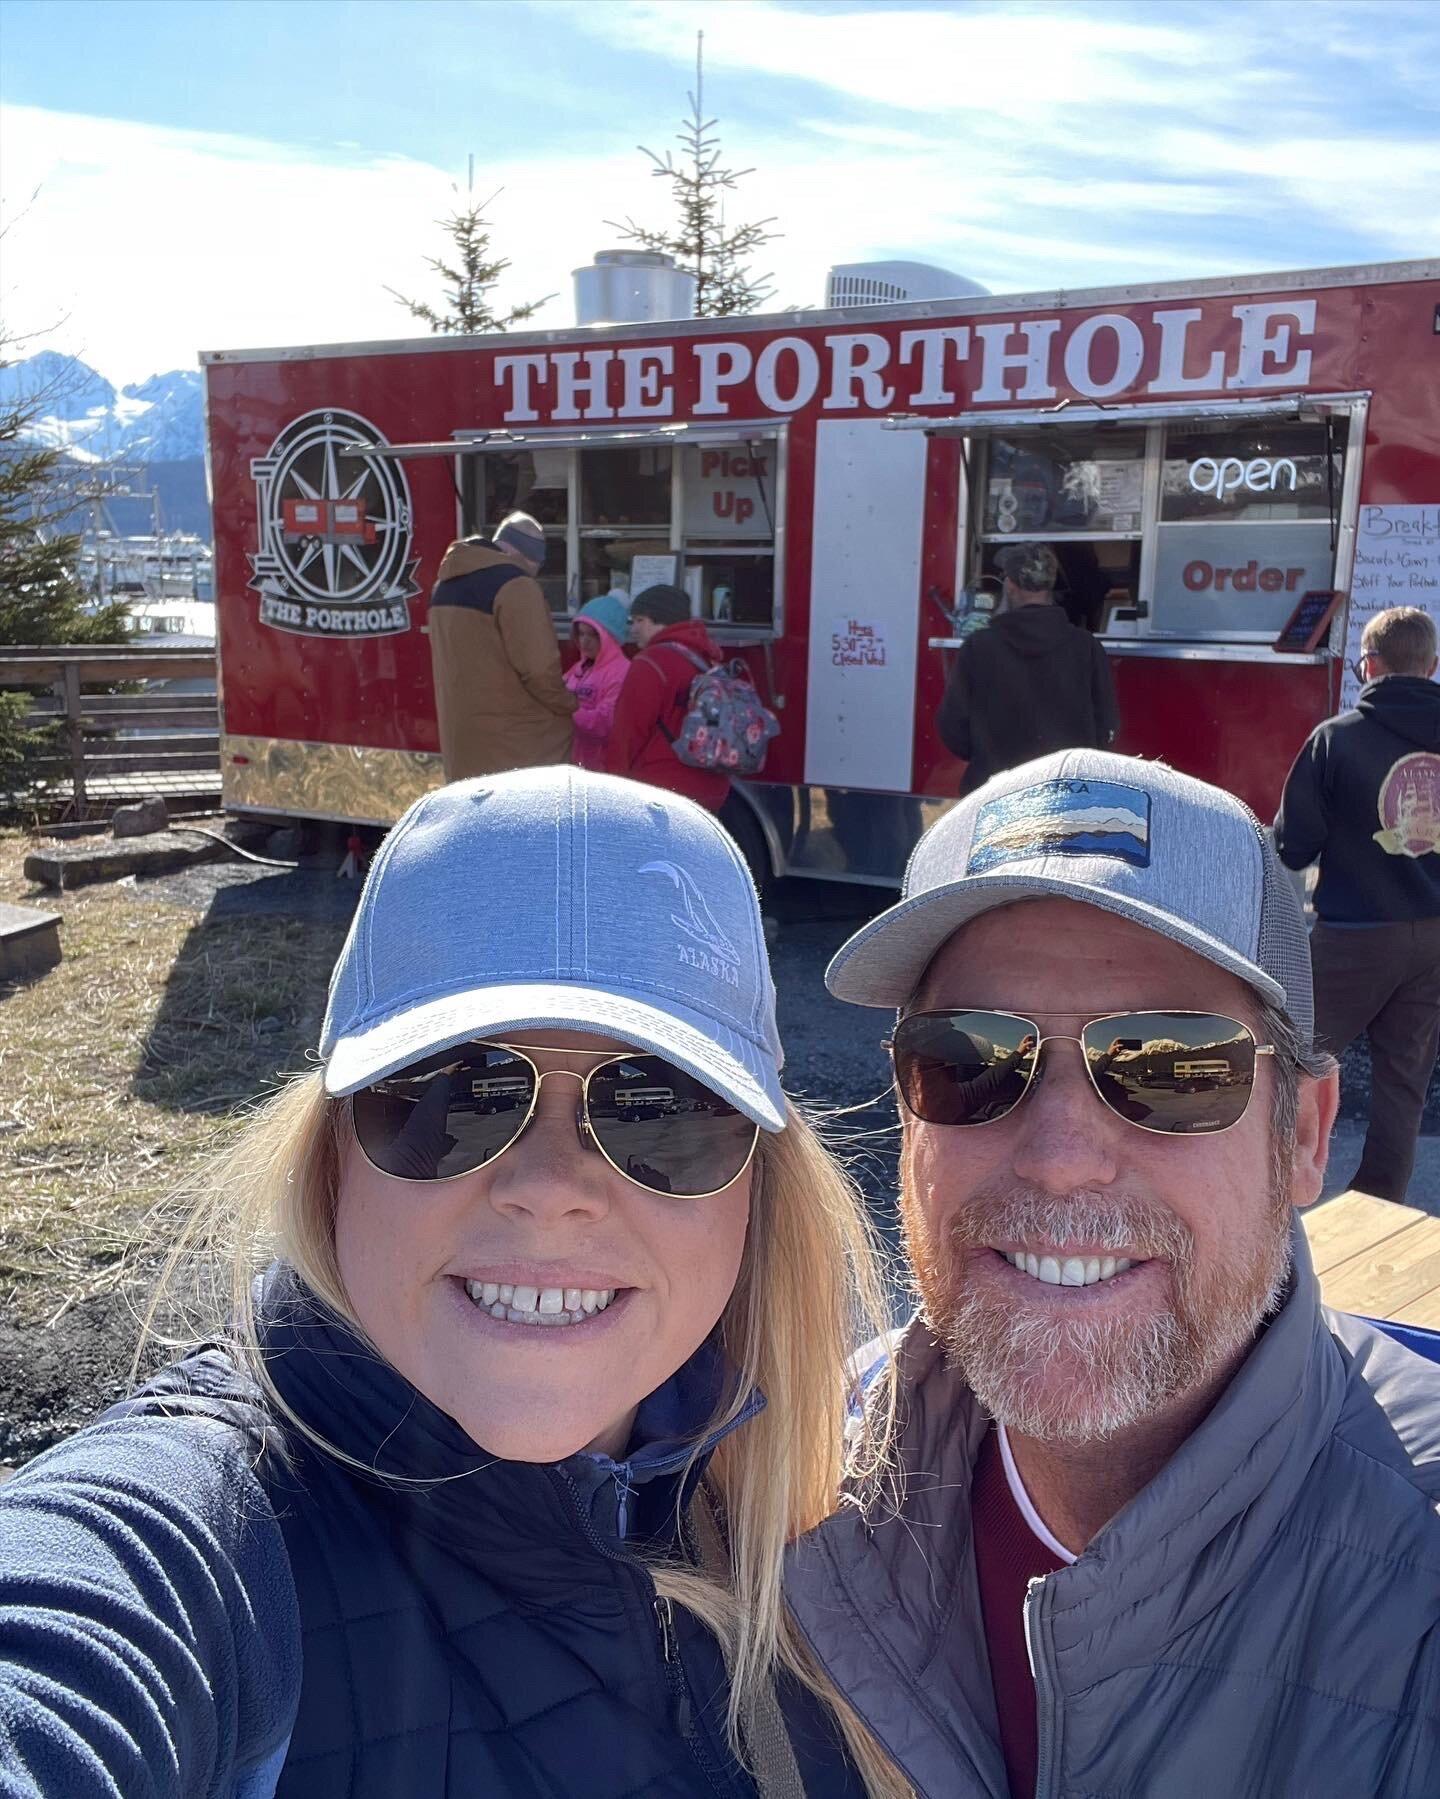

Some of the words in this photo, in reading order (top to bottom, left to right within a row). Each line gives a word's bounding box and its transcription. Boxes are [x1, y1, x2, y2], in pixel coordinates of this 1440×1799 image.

[494, 345, 674, 422] THE
[692, 299, 1317, 415] PORTHOLE
[701, 450, 768, 478] Pick
[1189, 457, 1297, 500] open
[713, 491, 753, 524] Up
[1182, 560, 1305, 592] Order
[265, 600, 302, 625] THE
[305, 606, 405, 630] PORTHOLE
[677, 943, 739, 988] ALASKA
